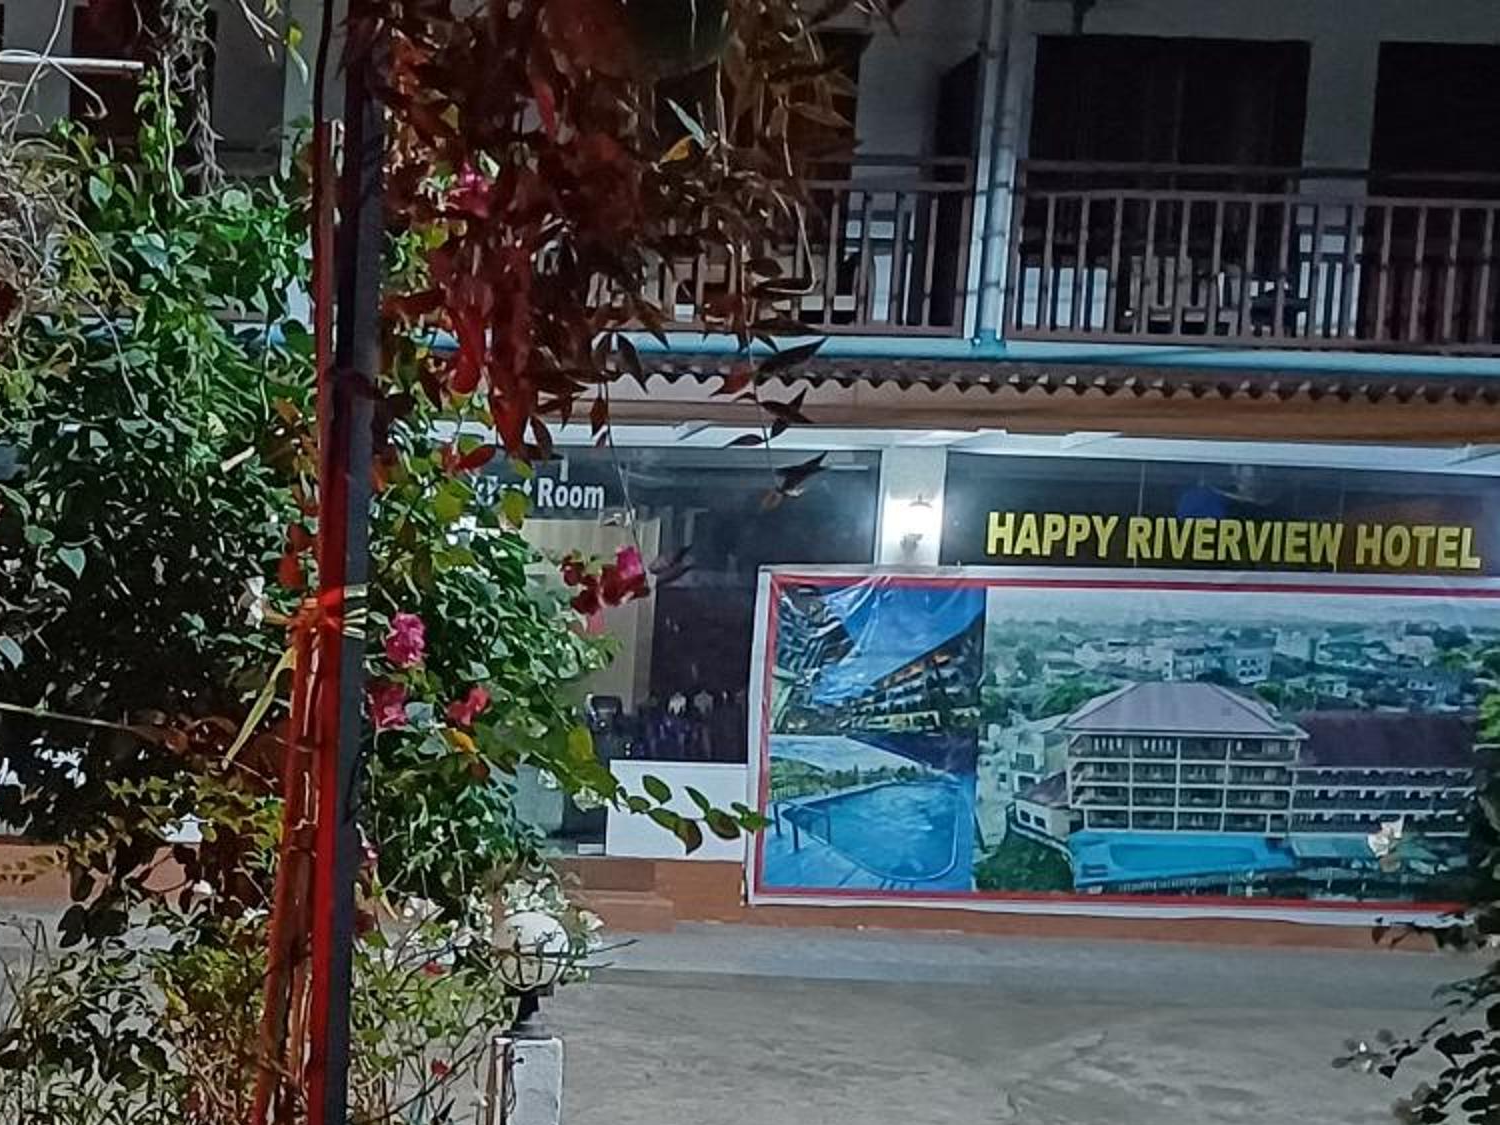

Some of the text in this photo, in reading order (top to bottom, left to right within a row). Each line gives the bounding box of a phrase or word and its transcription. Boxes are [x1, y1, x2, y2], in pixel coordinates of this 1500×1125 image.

[537, 477, 605, 509] Room
[986, 511, 1481, 569] HAPPY RIVERVIEW HOTEL
